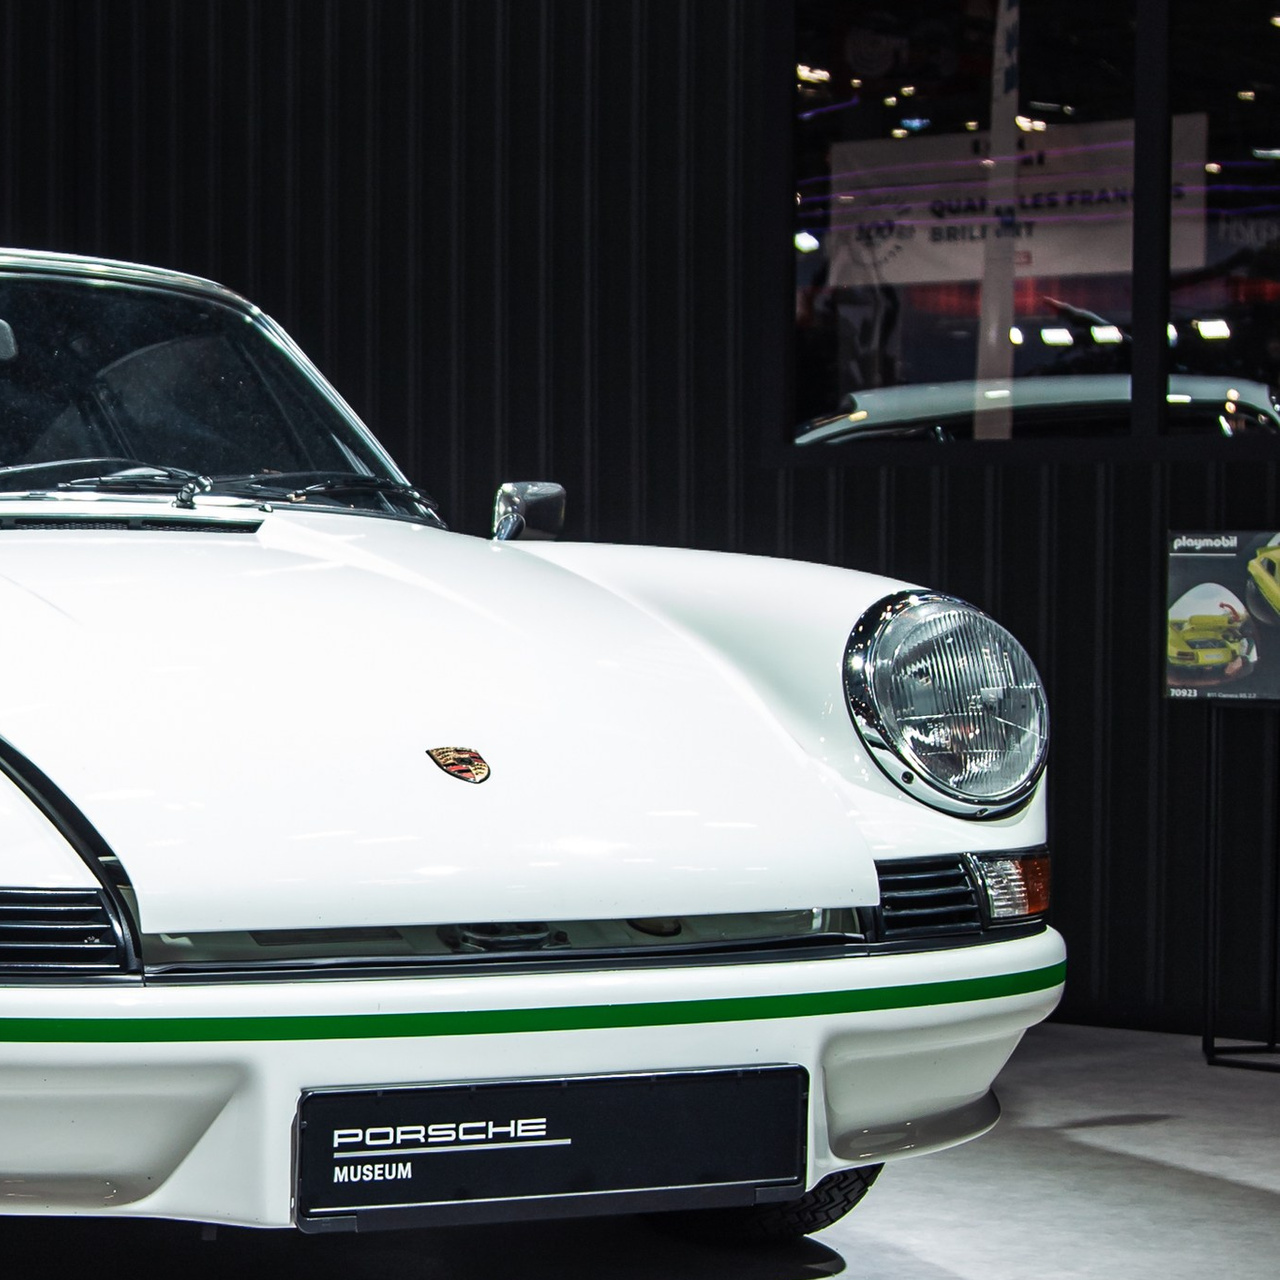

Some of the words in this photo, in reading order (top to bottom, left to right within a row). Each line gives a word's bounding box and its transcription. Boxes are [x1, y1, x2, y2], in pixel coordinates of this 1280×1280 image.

[1173, 535, 1238, 551] playmobil
[333, 1117, 547, 1148] PORSCHE
[333, 1162, 412, 1183] MUSEUM
